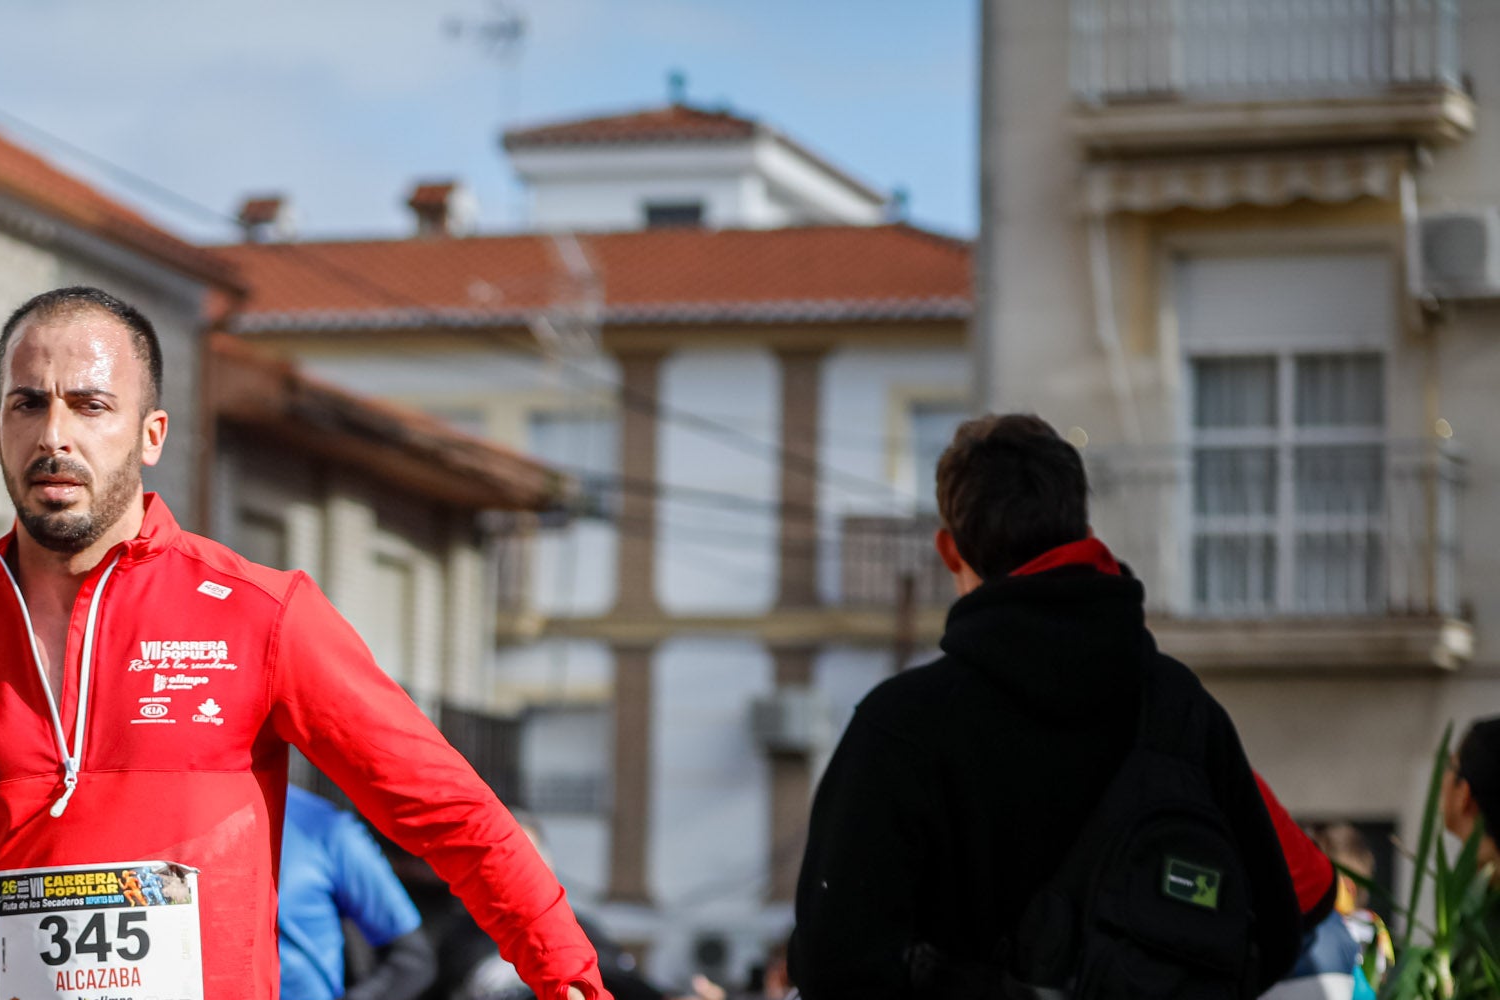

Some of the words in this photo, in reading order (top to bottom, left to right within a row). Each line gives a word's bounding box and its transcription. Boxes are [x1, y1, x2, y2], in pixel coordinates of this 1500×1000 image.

[161, 640, 228, 651] CARRERA
[161, 650, 228, 660] POPULAR
[168, 673, 209, 686] olimpo
[145, 706, 163, 715] KIA
[44, 872, 119, 888] CARRERA
[1, 880, 17, 895] 26
[29, 877, 44, 898] VII
[44, 884, 119, 898] POPULAR
[2, 901, 18, 911] Ruta
[18, 900, 28, 909] de
[29, 899, 41, 909] los
[42, 897, 84, 908] Secaderos
[38, 910, 151, 967] 345
[55, 966, 142, 992] ALCAZABA
